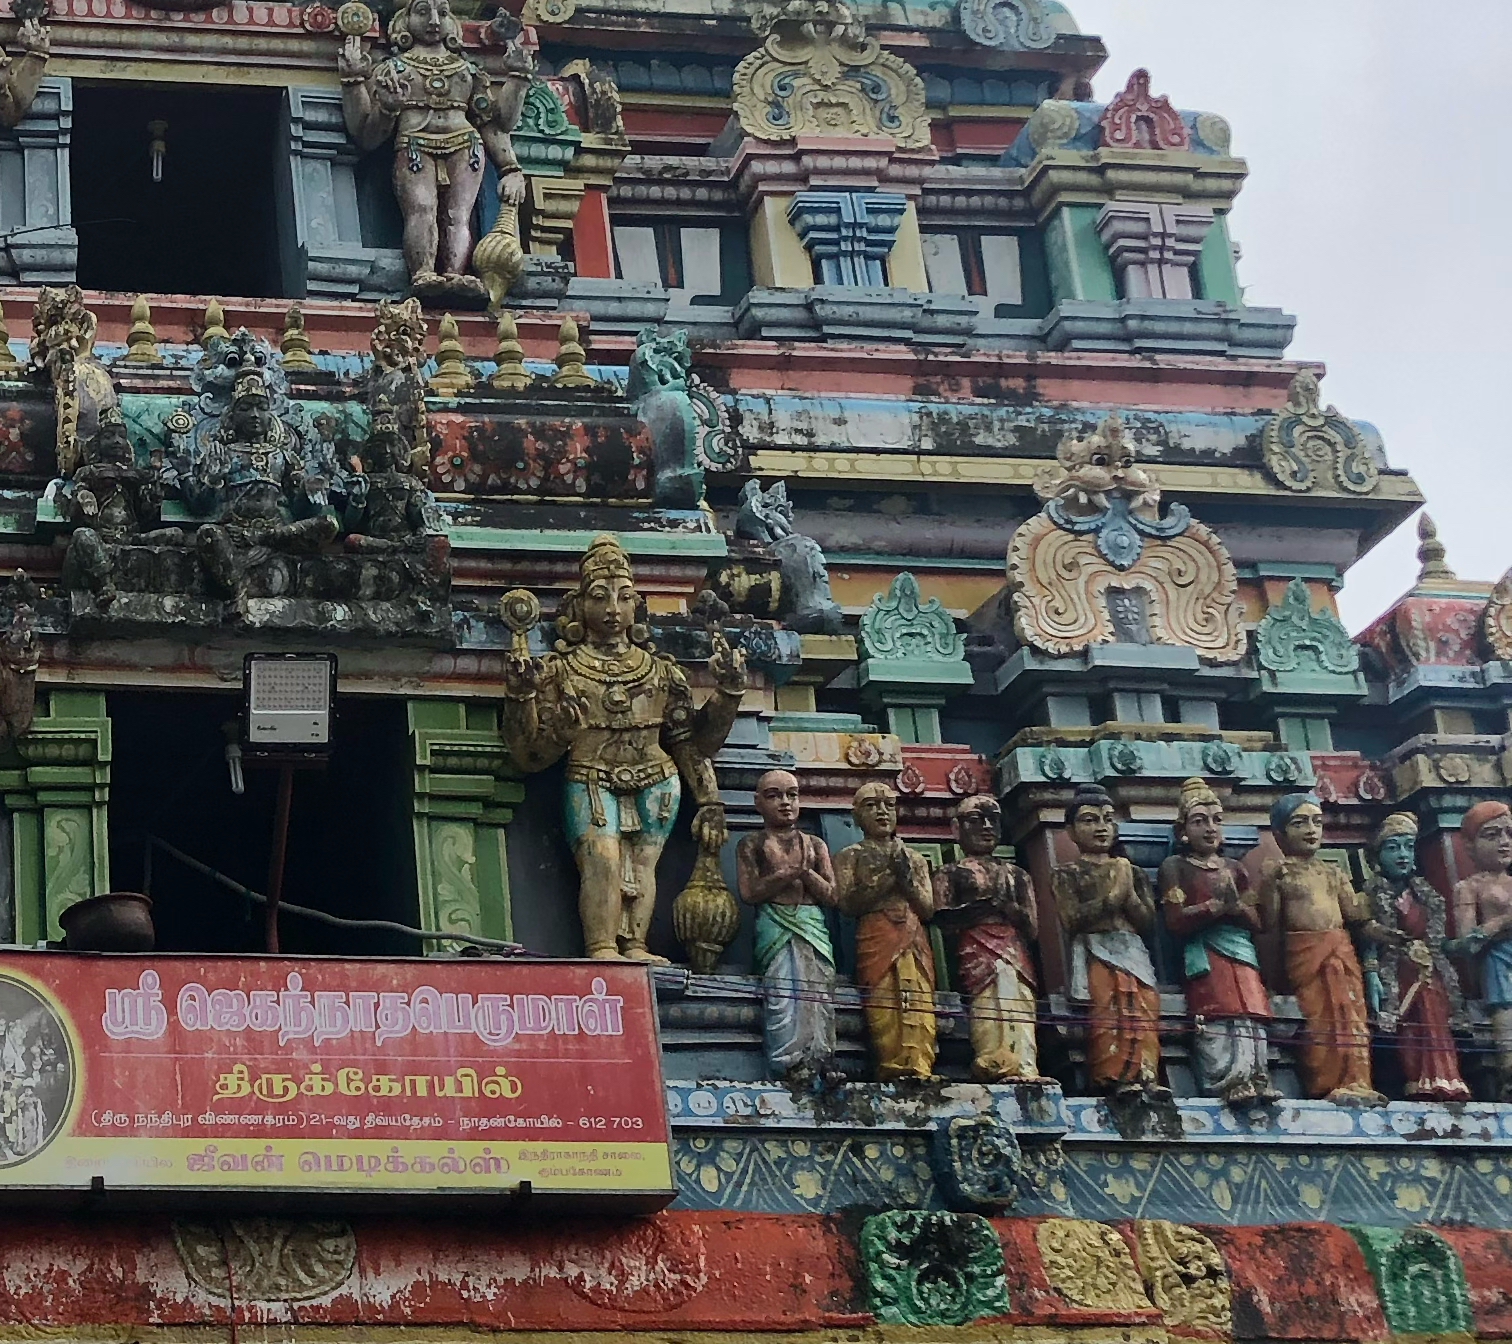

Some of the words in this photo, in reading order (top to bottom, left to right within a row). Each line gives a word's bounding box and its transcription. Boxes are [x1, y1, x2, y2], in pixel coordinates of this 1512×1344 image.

[102, 969, 168, 1039] ஸ்ரீ
[177, 971, 624, 1047] ஜெகந்நாதபெருமாள்
[212, 1063, 523, 1103] திருக்கோயில்
[91, 1110, 129, 1128] (திரு
[134, 1110, 193, 1128] நந்திபுர
[363, 1111, 443, 1131] திவ்யதேசம்
[459, 1114, 563, 1131] நாதன்கோயில்
[579, 1117, 606, 1129] 612
[611, 1117, 644, 1129] 703
[186, 1144, 286, 1173] ஜீவன்
[298, 1145, 511, 1178] மெடிக்கல்ஸ்
